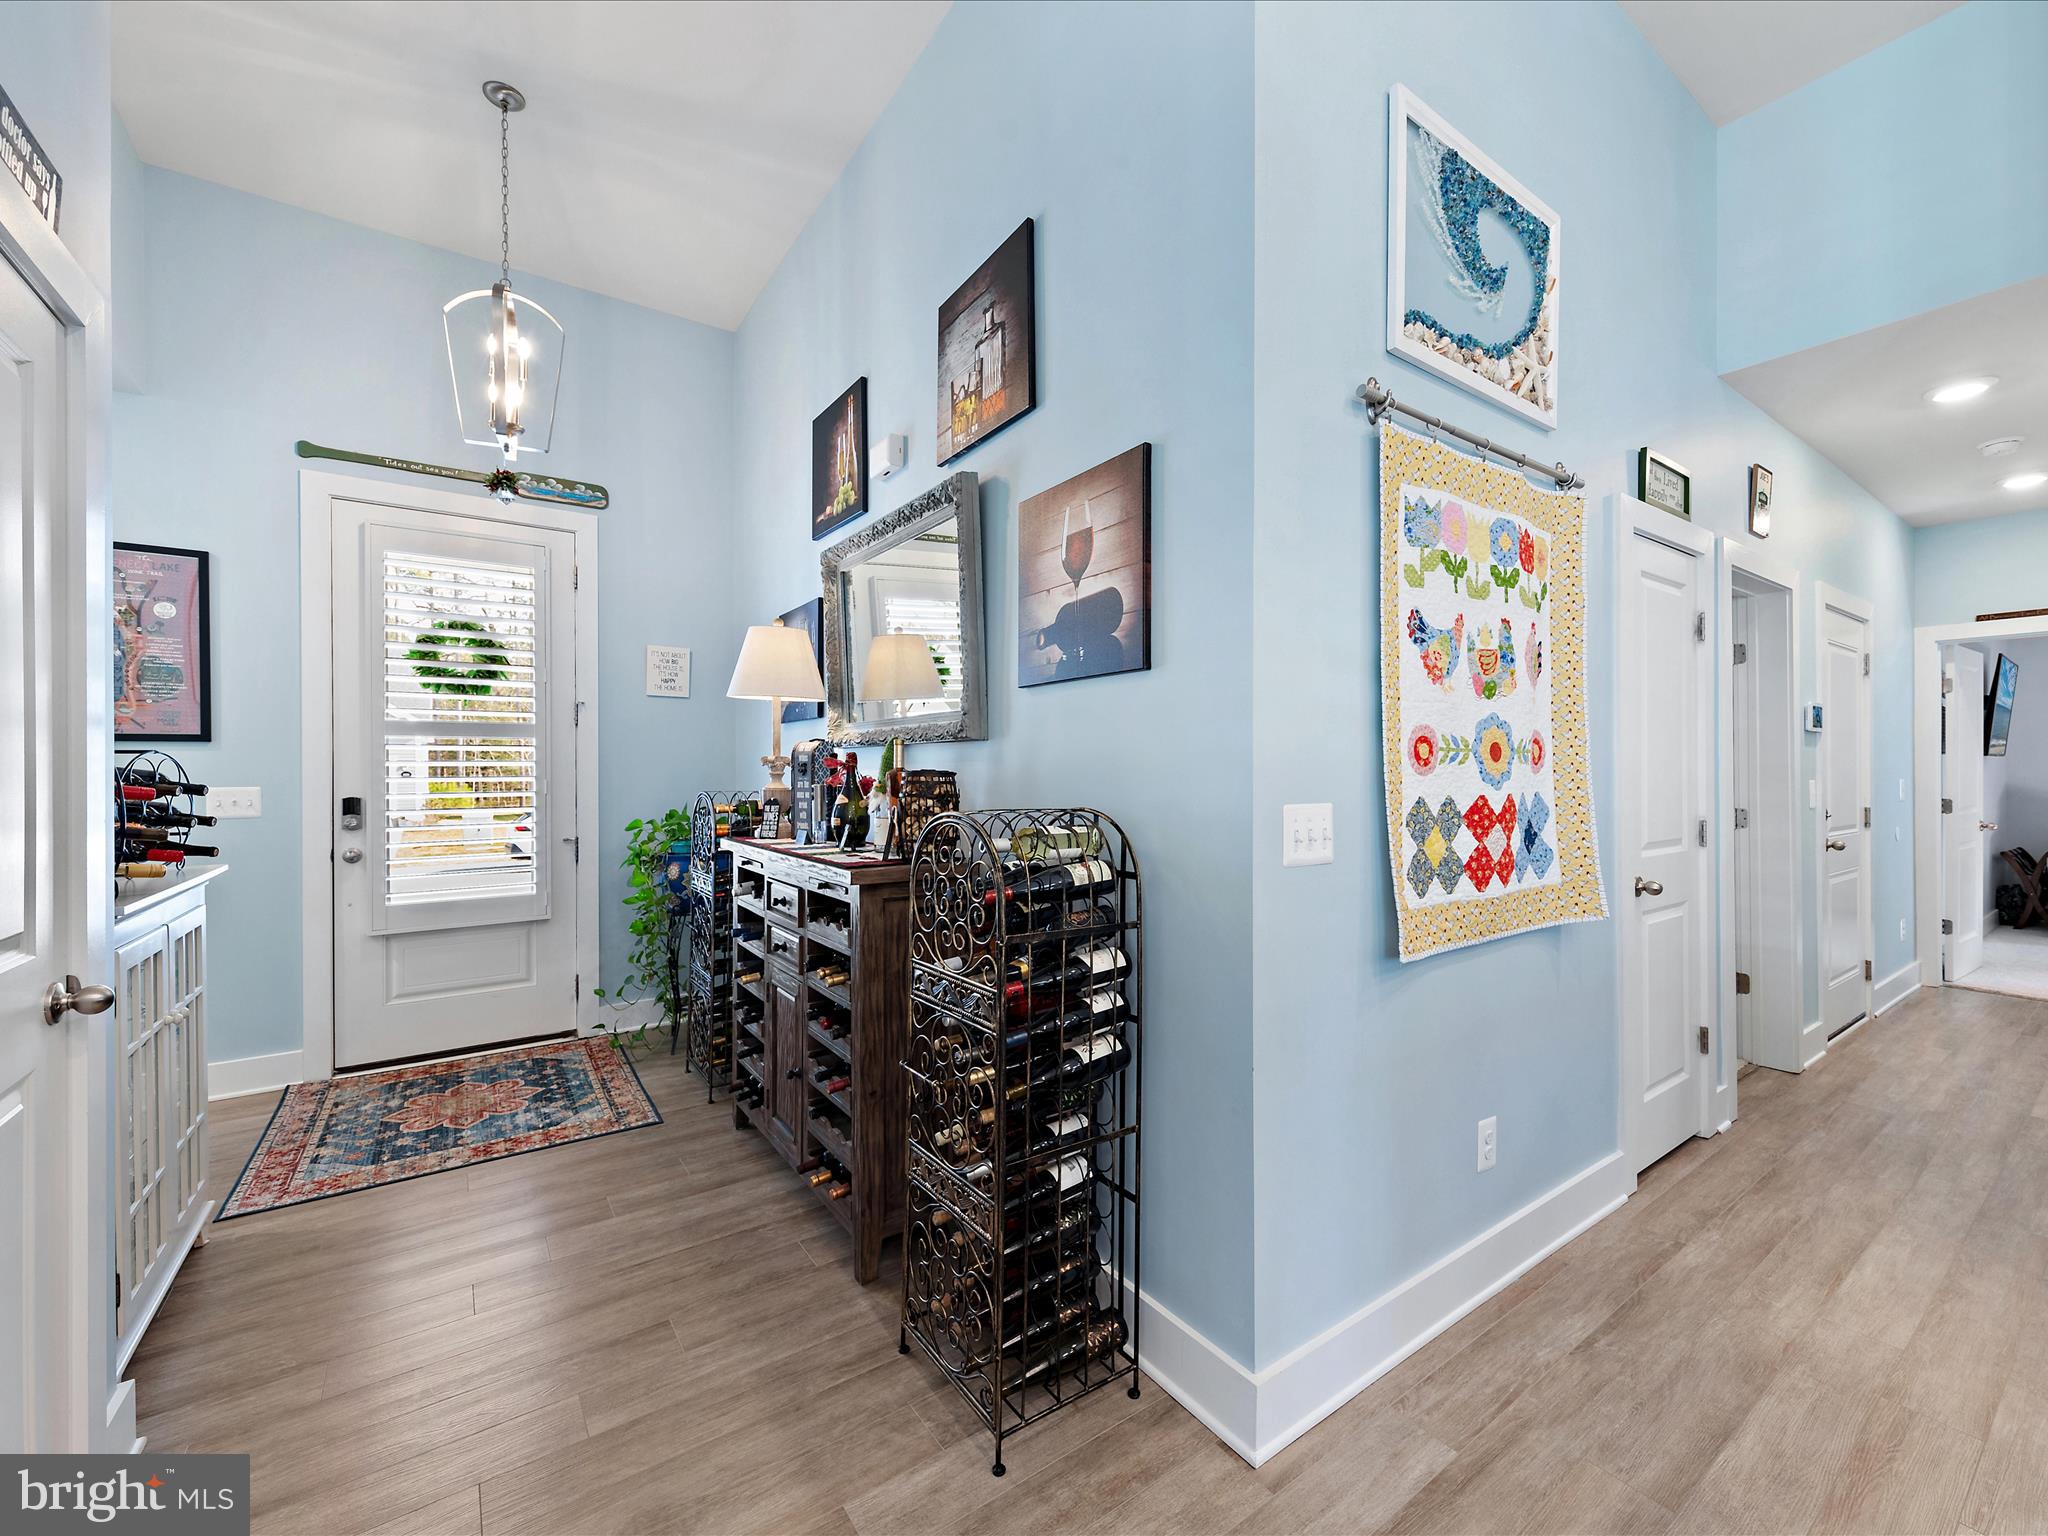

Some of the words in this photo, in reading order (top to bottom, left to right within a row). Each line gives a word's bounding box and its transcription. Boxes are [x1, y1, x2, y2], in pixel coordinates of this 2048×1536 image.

[0, 132, 24, 183] ttled
[24, 172, 37, 201] up
[2, 106, 31, 162] doctor
[33, 153, 51, 191] says
[152, 562, 180, 573] LAKE
